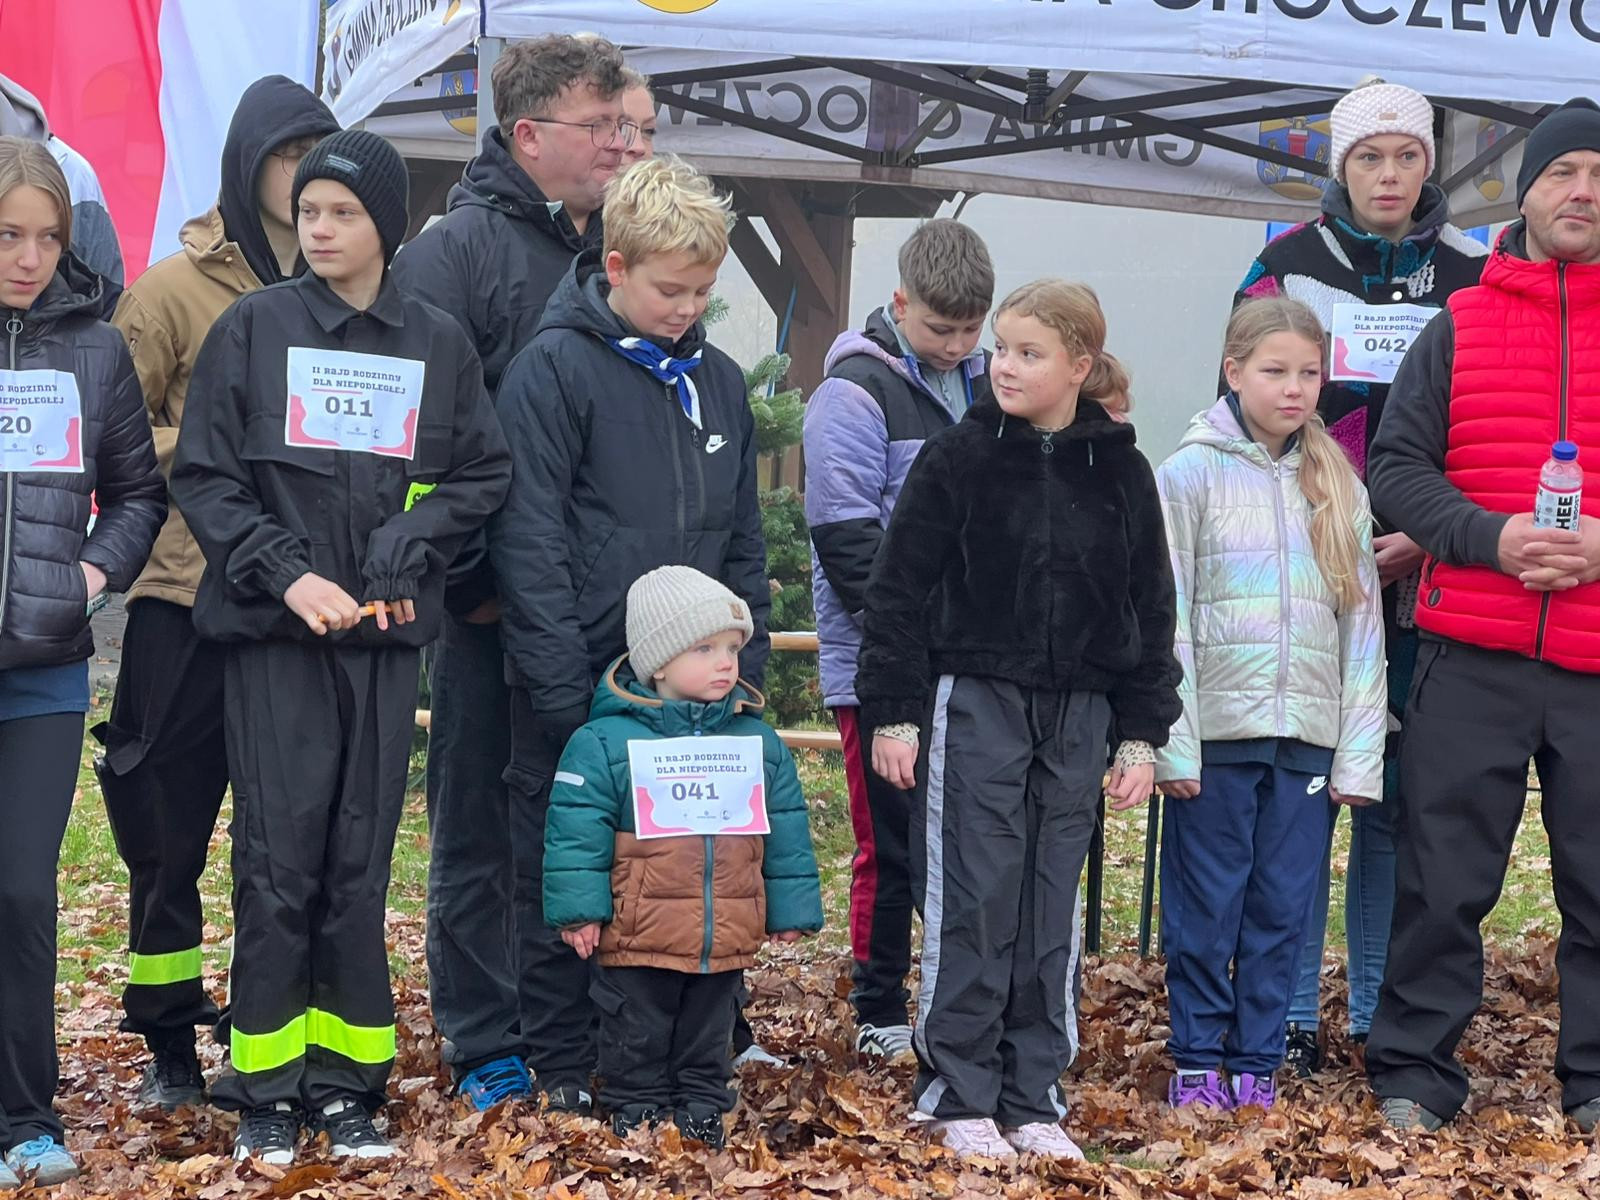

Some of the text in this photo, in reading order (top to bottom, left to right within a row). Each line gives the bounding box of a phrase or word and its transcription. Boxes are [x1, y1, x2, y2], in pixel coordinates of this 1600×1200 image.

[1364, 338, 1407, 353] 042
[313, 378, 332, 386] DLA
[325, 396, 373, 417] 011
[656, 766, 676, 774] DLA
[671, 782, 719, 801] 041
